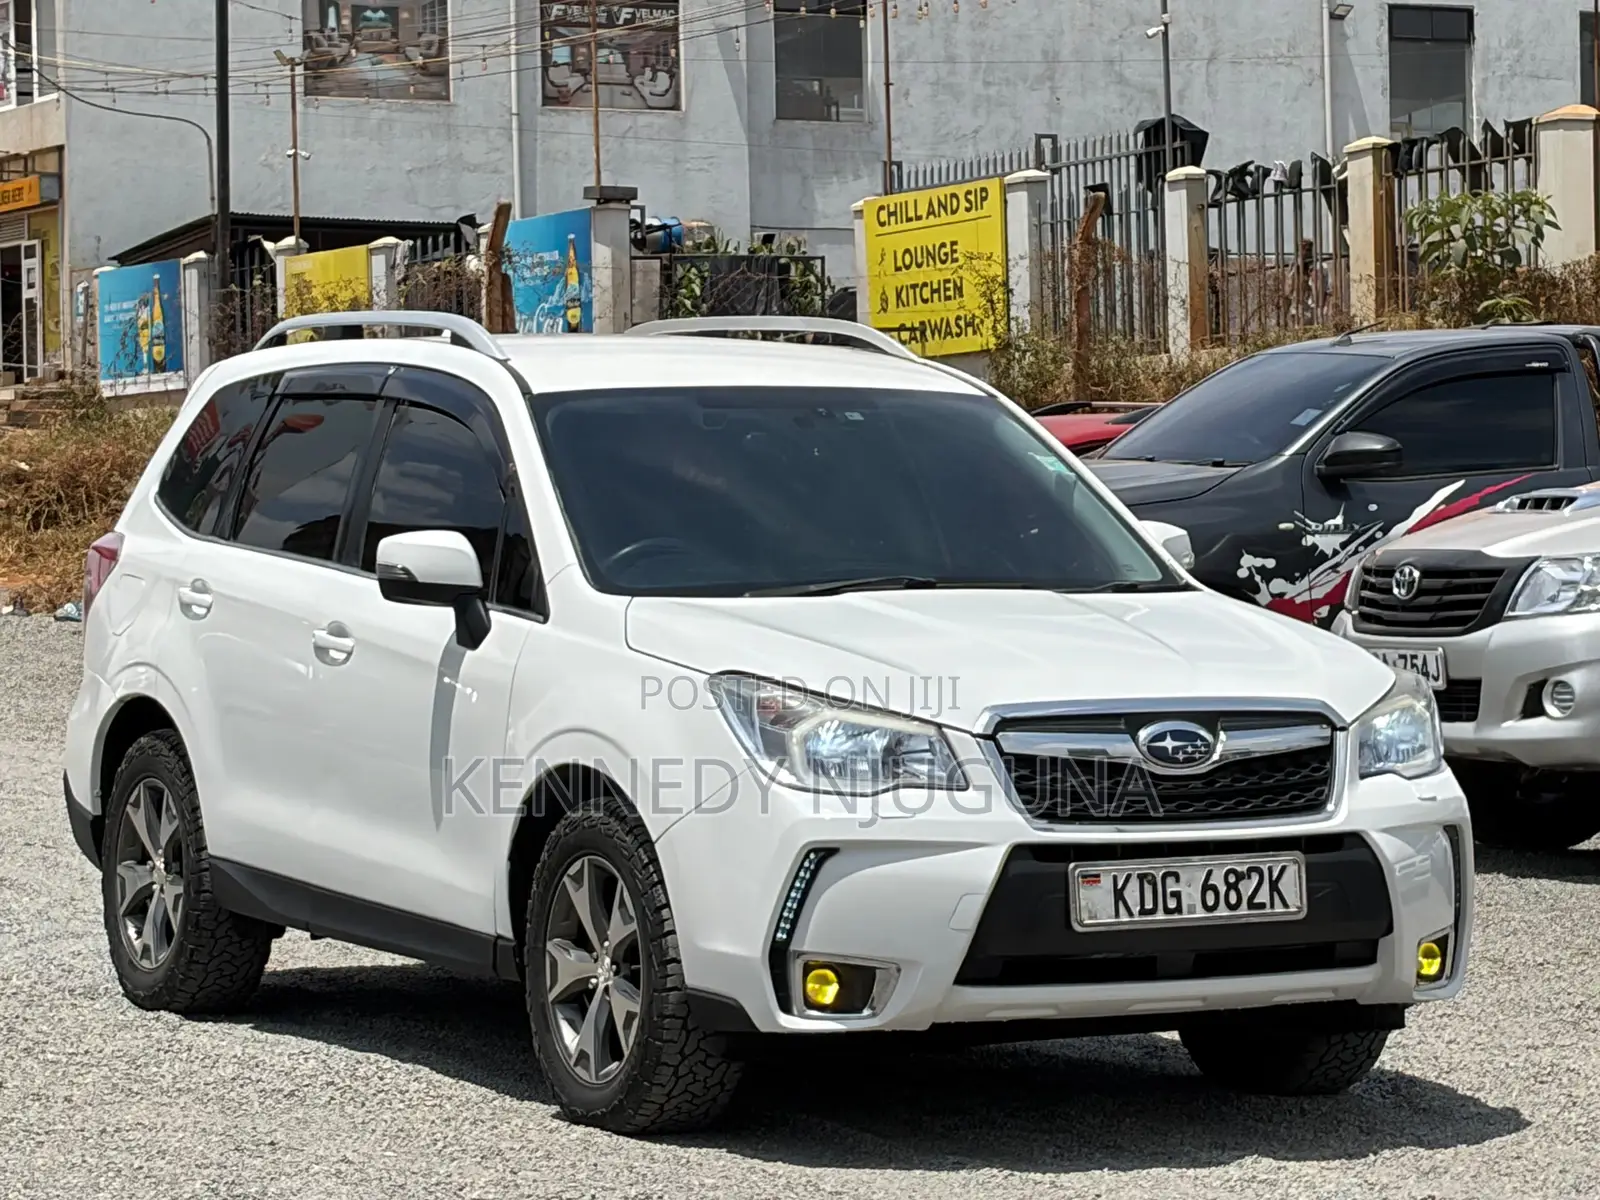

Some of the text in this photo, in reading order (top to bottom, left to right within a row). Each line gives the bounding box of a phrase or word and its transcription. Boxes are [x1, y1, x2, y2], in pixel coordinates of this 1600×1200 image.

[876, 186, 989, 228] CHILL AND SIP
[893, 240, 959, 273] LOUNGE
[895, 275, 965, 309] KITCHEN
[897, 313, 978, 346] CARWASH
[1111, 864, 1291, 919] KDG 682K
